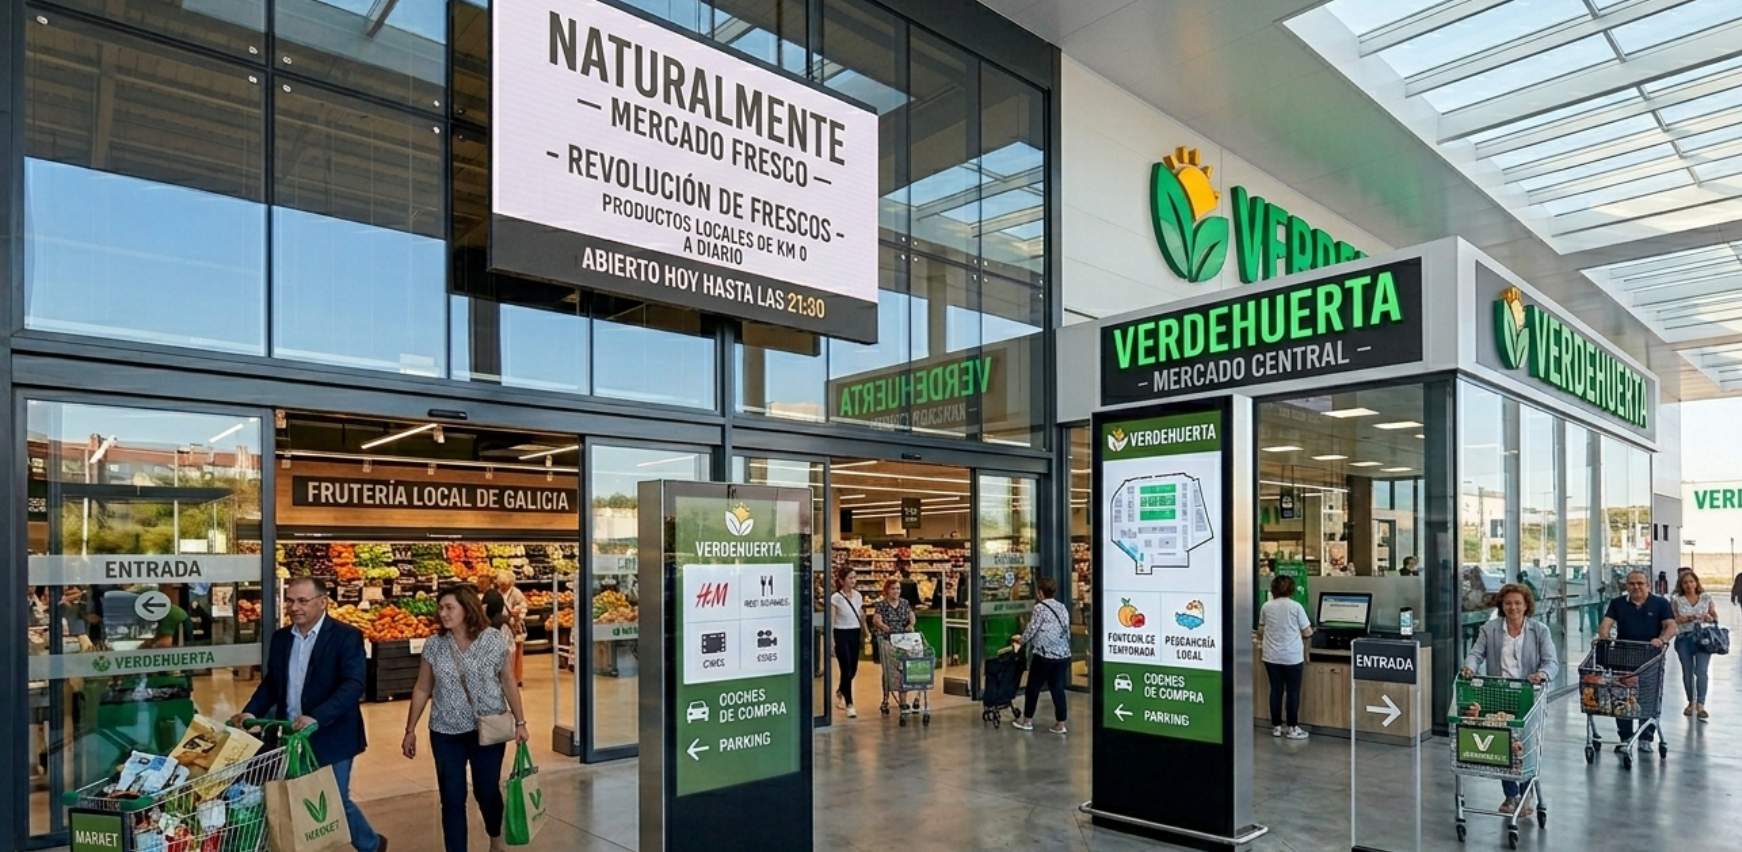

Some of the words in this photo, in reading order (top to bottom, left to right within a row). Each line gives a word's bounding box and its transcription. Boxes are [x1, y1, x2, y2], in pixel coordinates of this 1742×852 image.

[548, 10, 845, 166] NATURALMENTE
[611, 97, 724, 160] MERCADO
[732, 138, 808, 188] FRESCO
[568, 144, 711, 211] REVOLUCIÓN
[719, 188, 744, 219] DE
[750, 197, 832, 242] FRESCOS
[602, 193, 691, 232] PRODUCTOS
[696, 219, 753, 248] LOCALES
[757, 235, 773, 253] DE
[777, 240, 796, 259] KM
[683, 236, 693, 253] A
[697, 239, 743, 265] DIARIO
[582, 247, 660, 284] ABIERTO
[664, 265, 699, 292] HOY
[703, 275, 753, 304] HASTA
[757, 285, 785, 310] LAS
[787, 292, 825, 319] 21:30
[1113, 271, 1402, 369] VERDEHUERTA
[1153, 357, 1245, 392] MERCADO
[1252, 340, 1350, 378] CENTRAL
[1529, 305, 1648, 428] VERDEHUERTA
[1129, 423, 1216, 447] VERDEHUERTA
[307, 479, 408, 505] FRUTERÍA
[413, 486, 472, 508] LOCAL
[477, 488, 498, 509] DE
[695, 541, 782, 557] VERDEHUERTA
[105, 560, 201, 578] ENTRADA
[115, 651, 215, 669] VERDEHUERTA
[1356, 654, 1414, 671] ENTRADA
[720, 688, 766, 706] COCHES
[1143, 686, 1158, 698] DE
[1159, 688, 1204, 704] COMPRA
[720, 708, 735, 723] DE
[738, 701, 787, 720] COMPRA
[1144, 710, 1190, 726] PARKING
[720, 731, 771, 752] PARKING
[75, 830, 119, 847] MARKET
